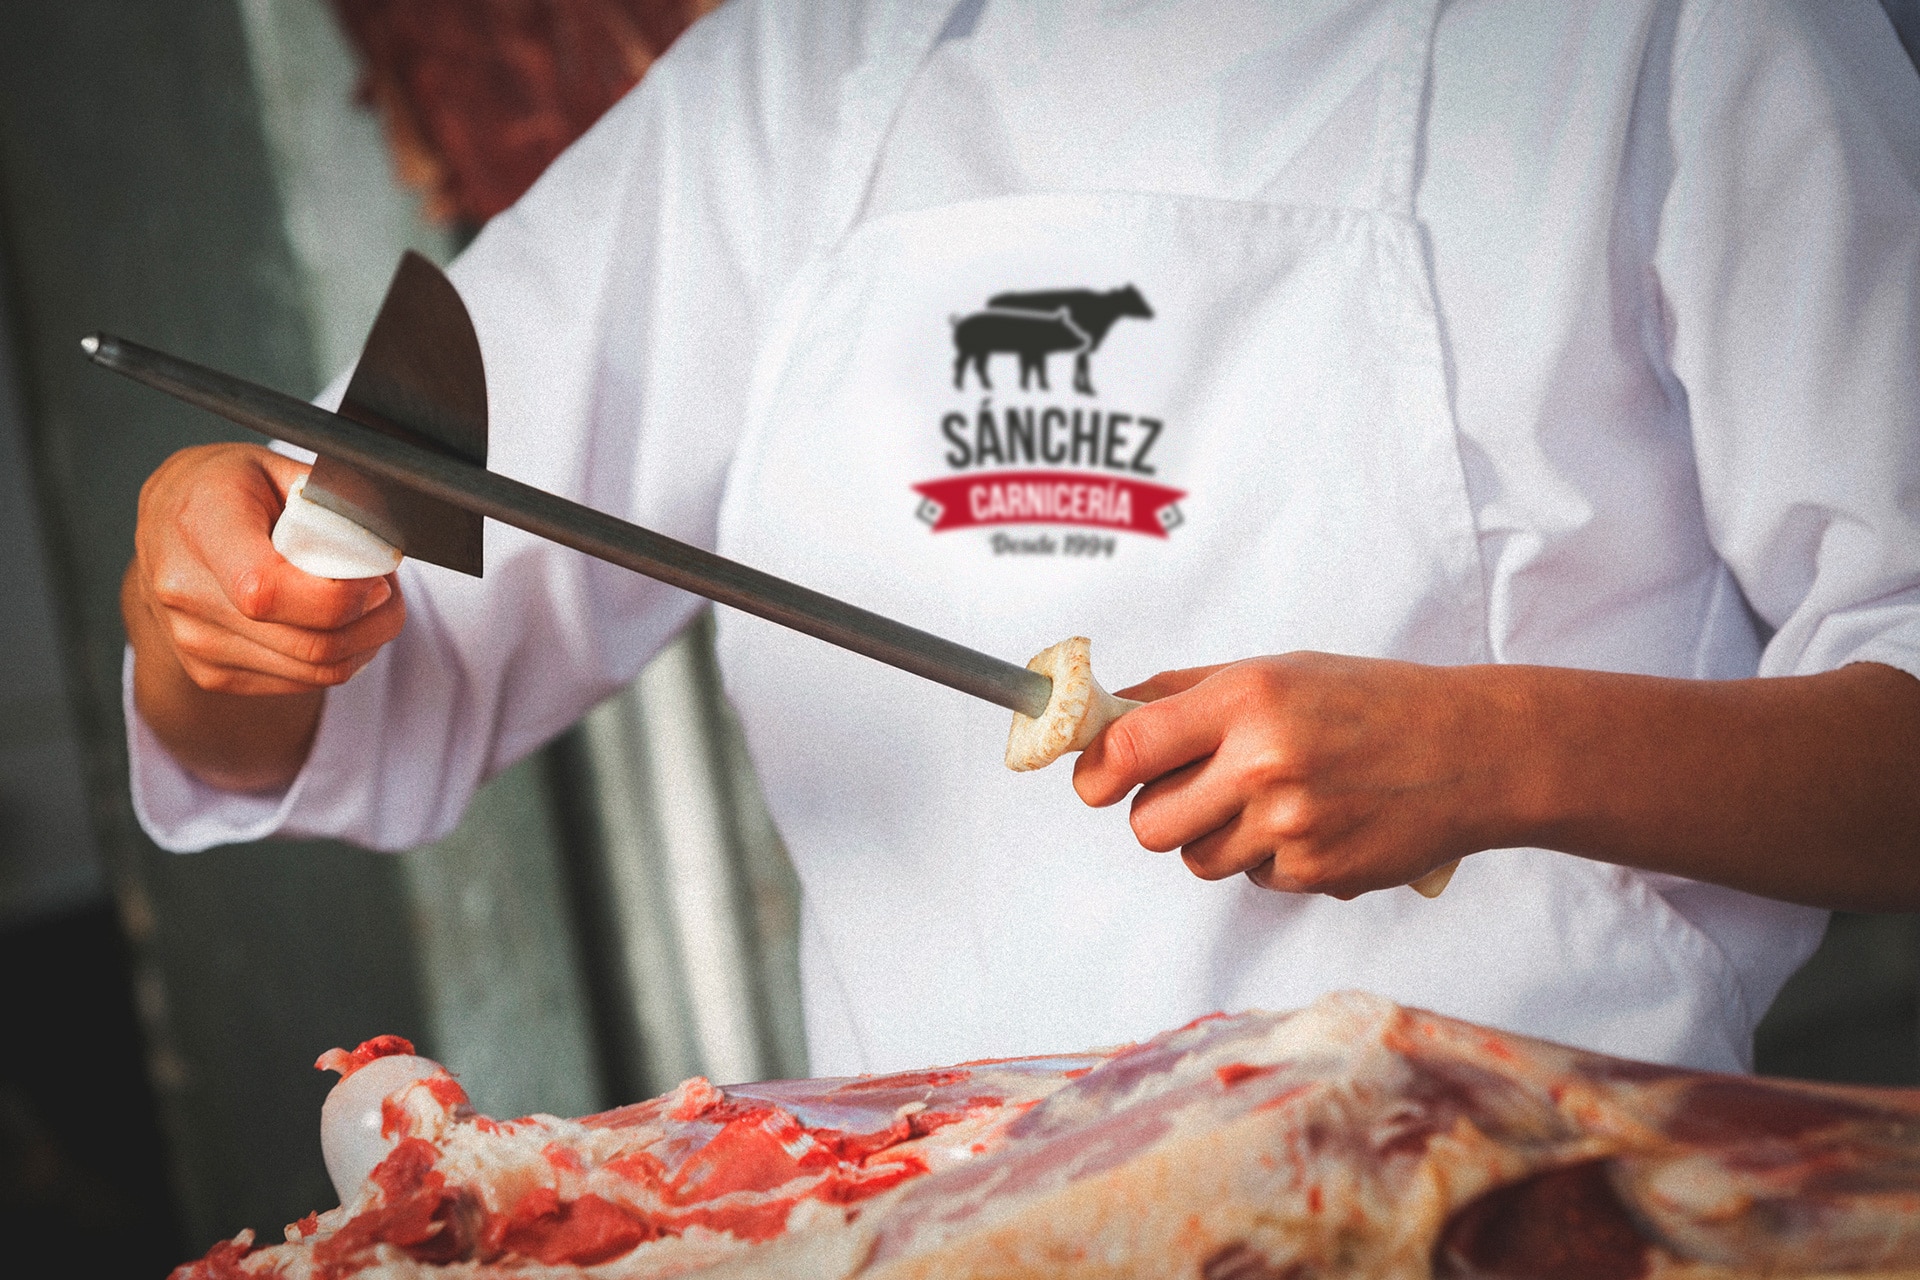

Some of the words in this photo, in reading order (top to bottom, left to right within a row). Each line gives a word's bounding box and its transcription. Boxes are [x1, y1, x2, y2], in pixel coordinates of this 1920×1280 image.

[941, 398, 1164, 475] SÁNCHEZ
[968, 481, 1132, 525] CARNICERÍA
[990, 532, 1057, 556] Desde
